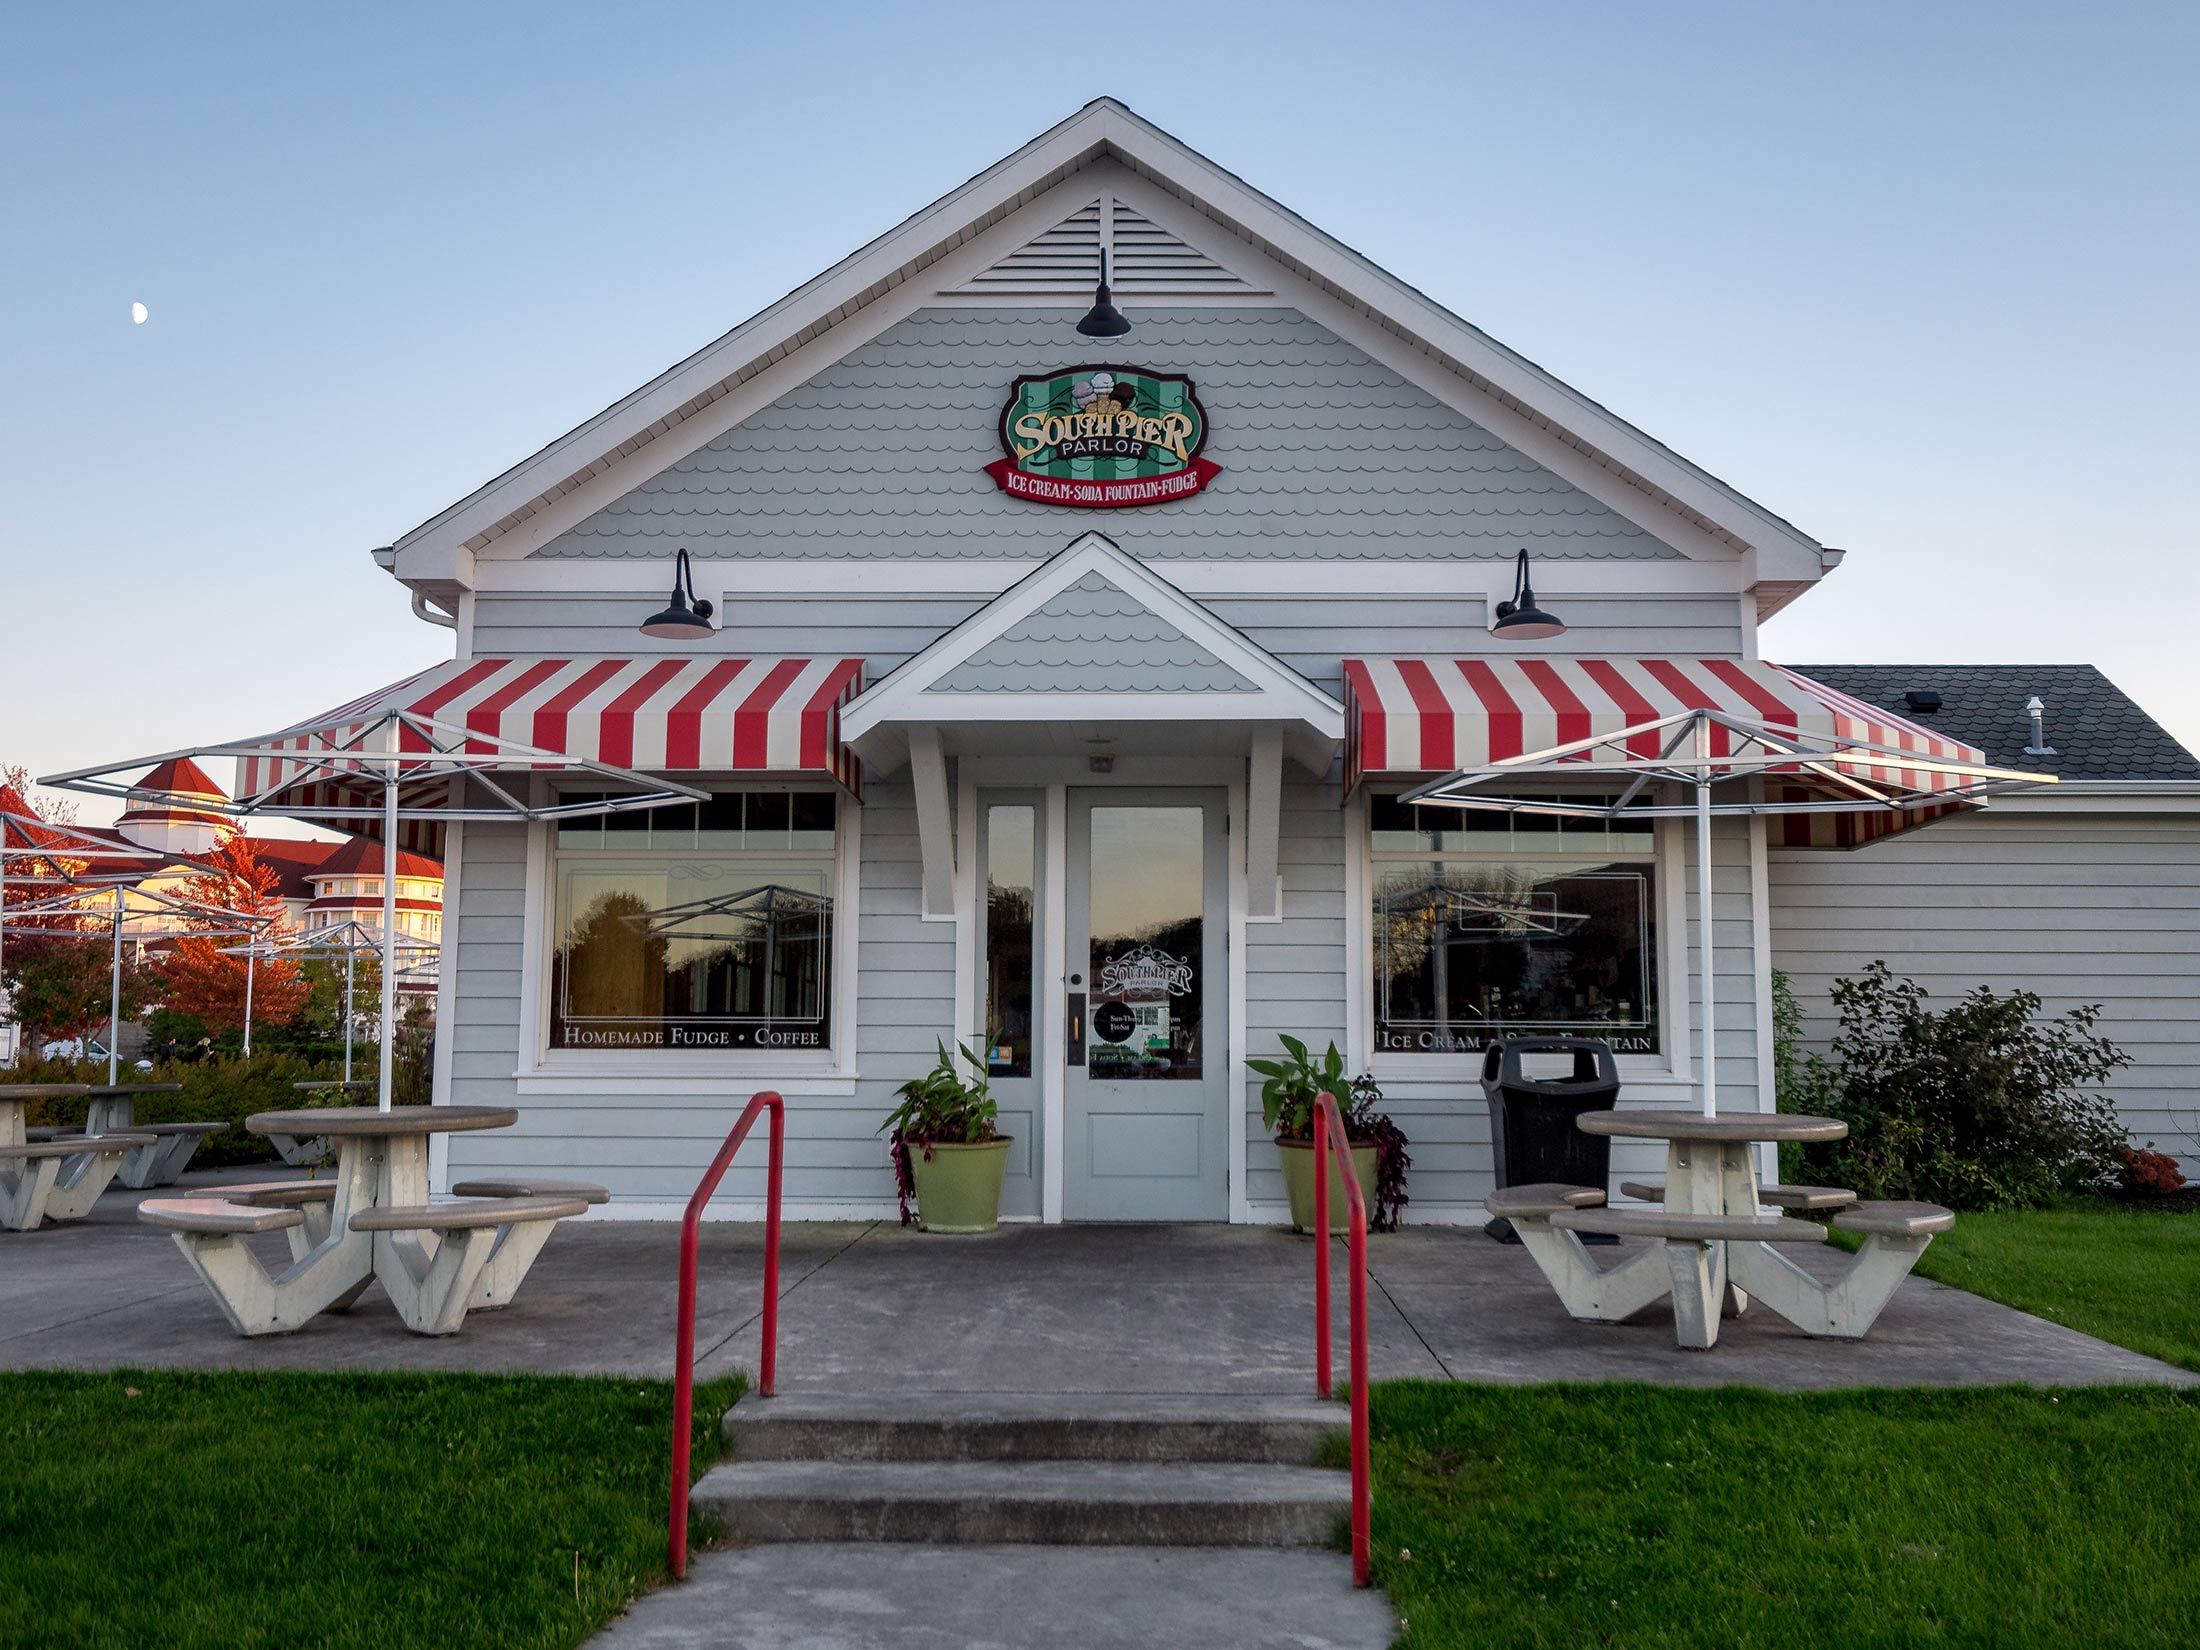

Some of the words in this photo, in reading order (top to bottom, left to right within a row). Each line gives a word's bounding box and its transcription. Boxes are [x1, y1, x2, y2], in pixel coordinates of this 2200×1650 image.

[1014, 411, 1114, 461] SOUTH
[1115, 410, 1193, 462] PIER
[1062, 439, 1143, 455] PARLOR
[1008, 471, 1028, 492] ICE
[1029, 479, 1071, 499] CREAM
[1073, 485, 1103, 501] SODA
[1105, 481, 1158, 501] FOUNTAIN
[1160, 471, 1197, 495] FUDGE
[1101, 965, 1151, 993] SOUTH
[563, 1027, 664, 1044] HOMEMADE
[671, 1028, 729, 1045] FUDGE
[754, 1028, 819, 1045] COFFEE
[1382, 1031, 1411, 1048] ICE
[1418, 1031, 1480, 1049] CREAM
[1560, 1032, 1651, 1050] NTAIN
